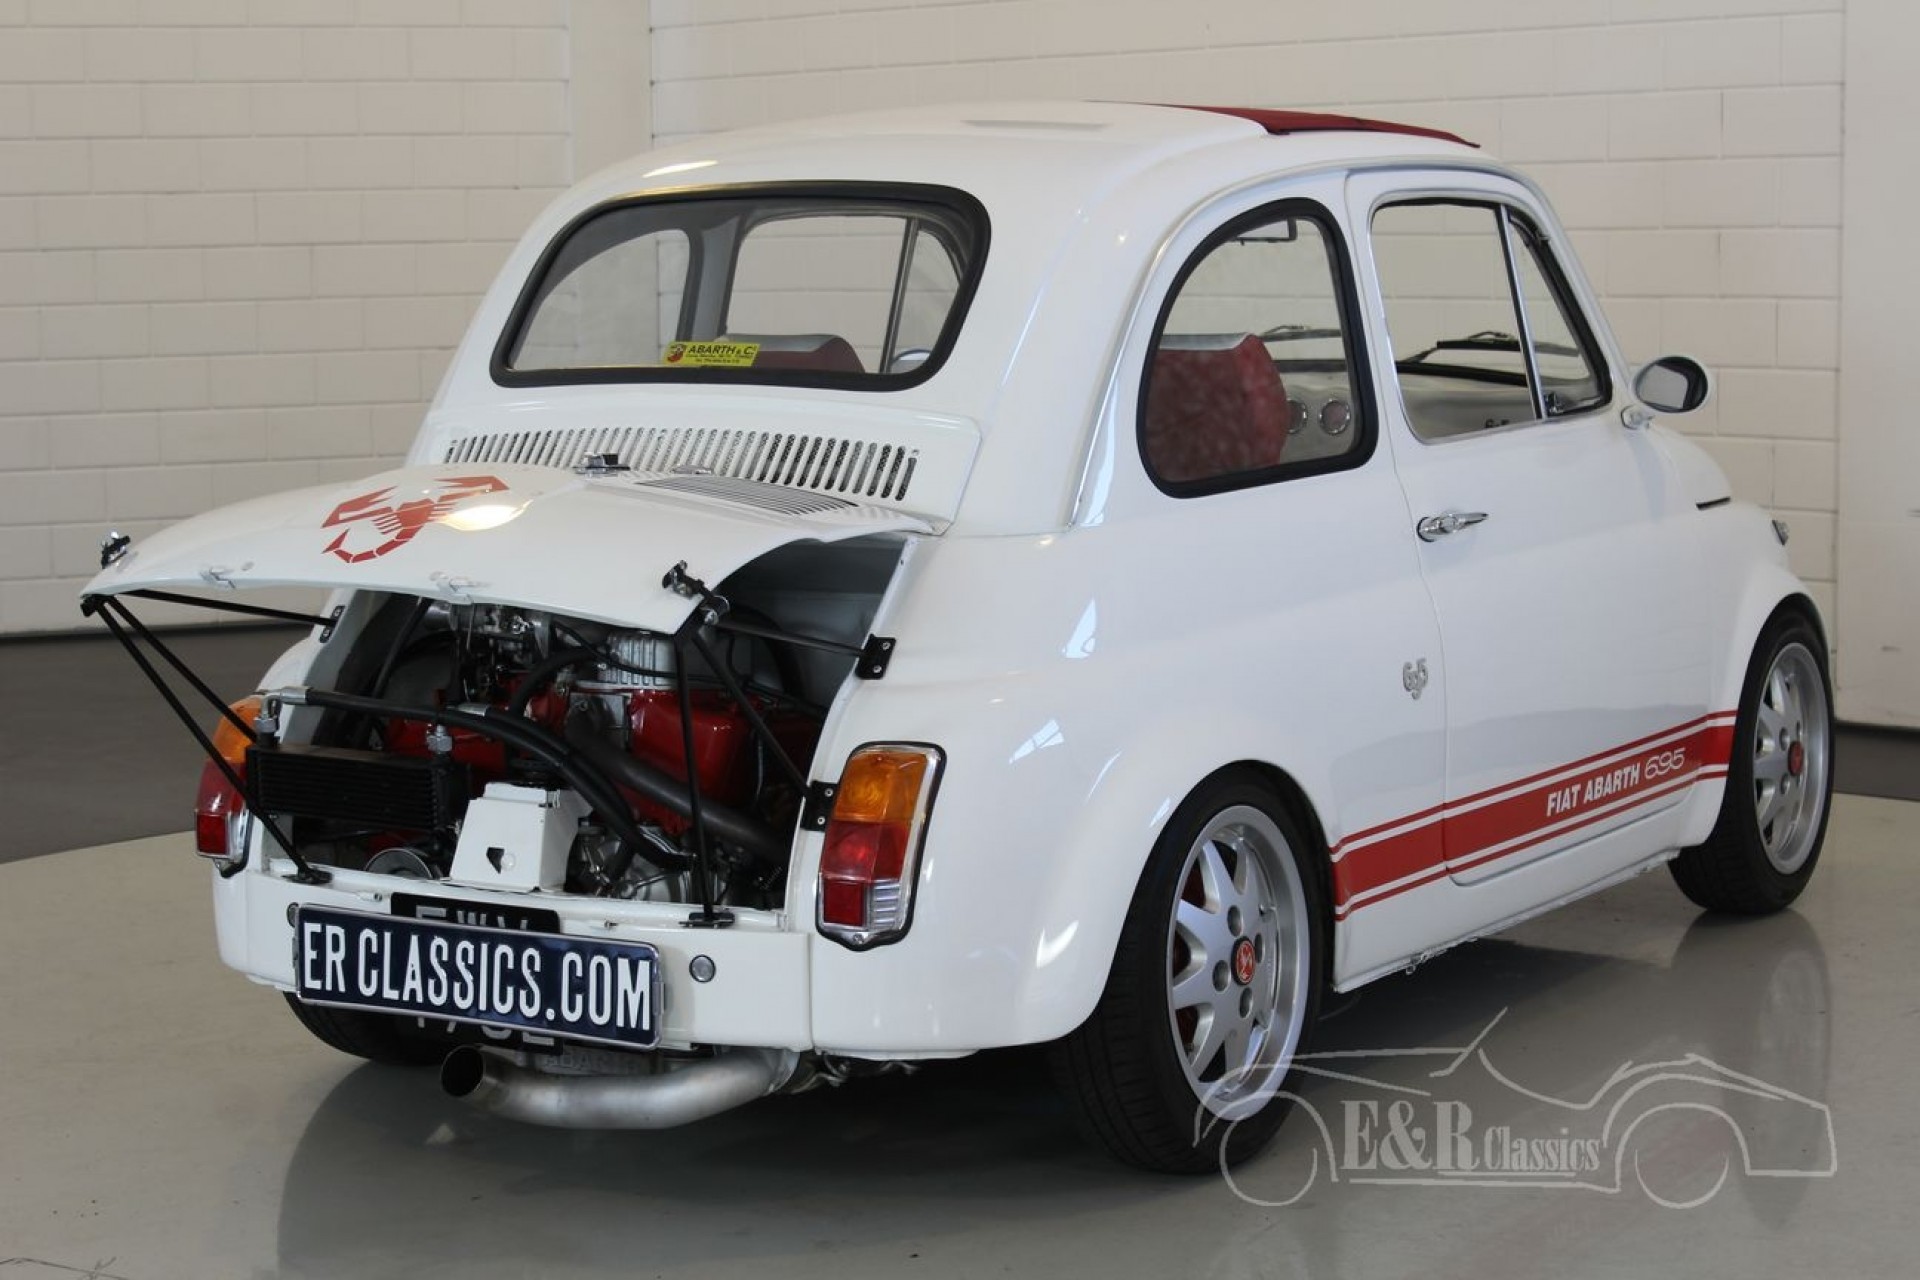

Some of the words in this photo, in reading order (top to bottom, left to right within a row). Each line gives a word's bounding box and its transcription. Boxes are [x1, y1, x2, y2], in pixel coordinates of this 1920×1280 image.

[688, 344, 735, 355] ABARTH
[1546, 783, 1582, 817] FIAT
[1583, 762, 1641, 804] ABARTH
[1644, 747, 1686, 780] 695
[303, 922, 347, 993] ER
[357, 928, 653, 1032] CLASSICS.COM
